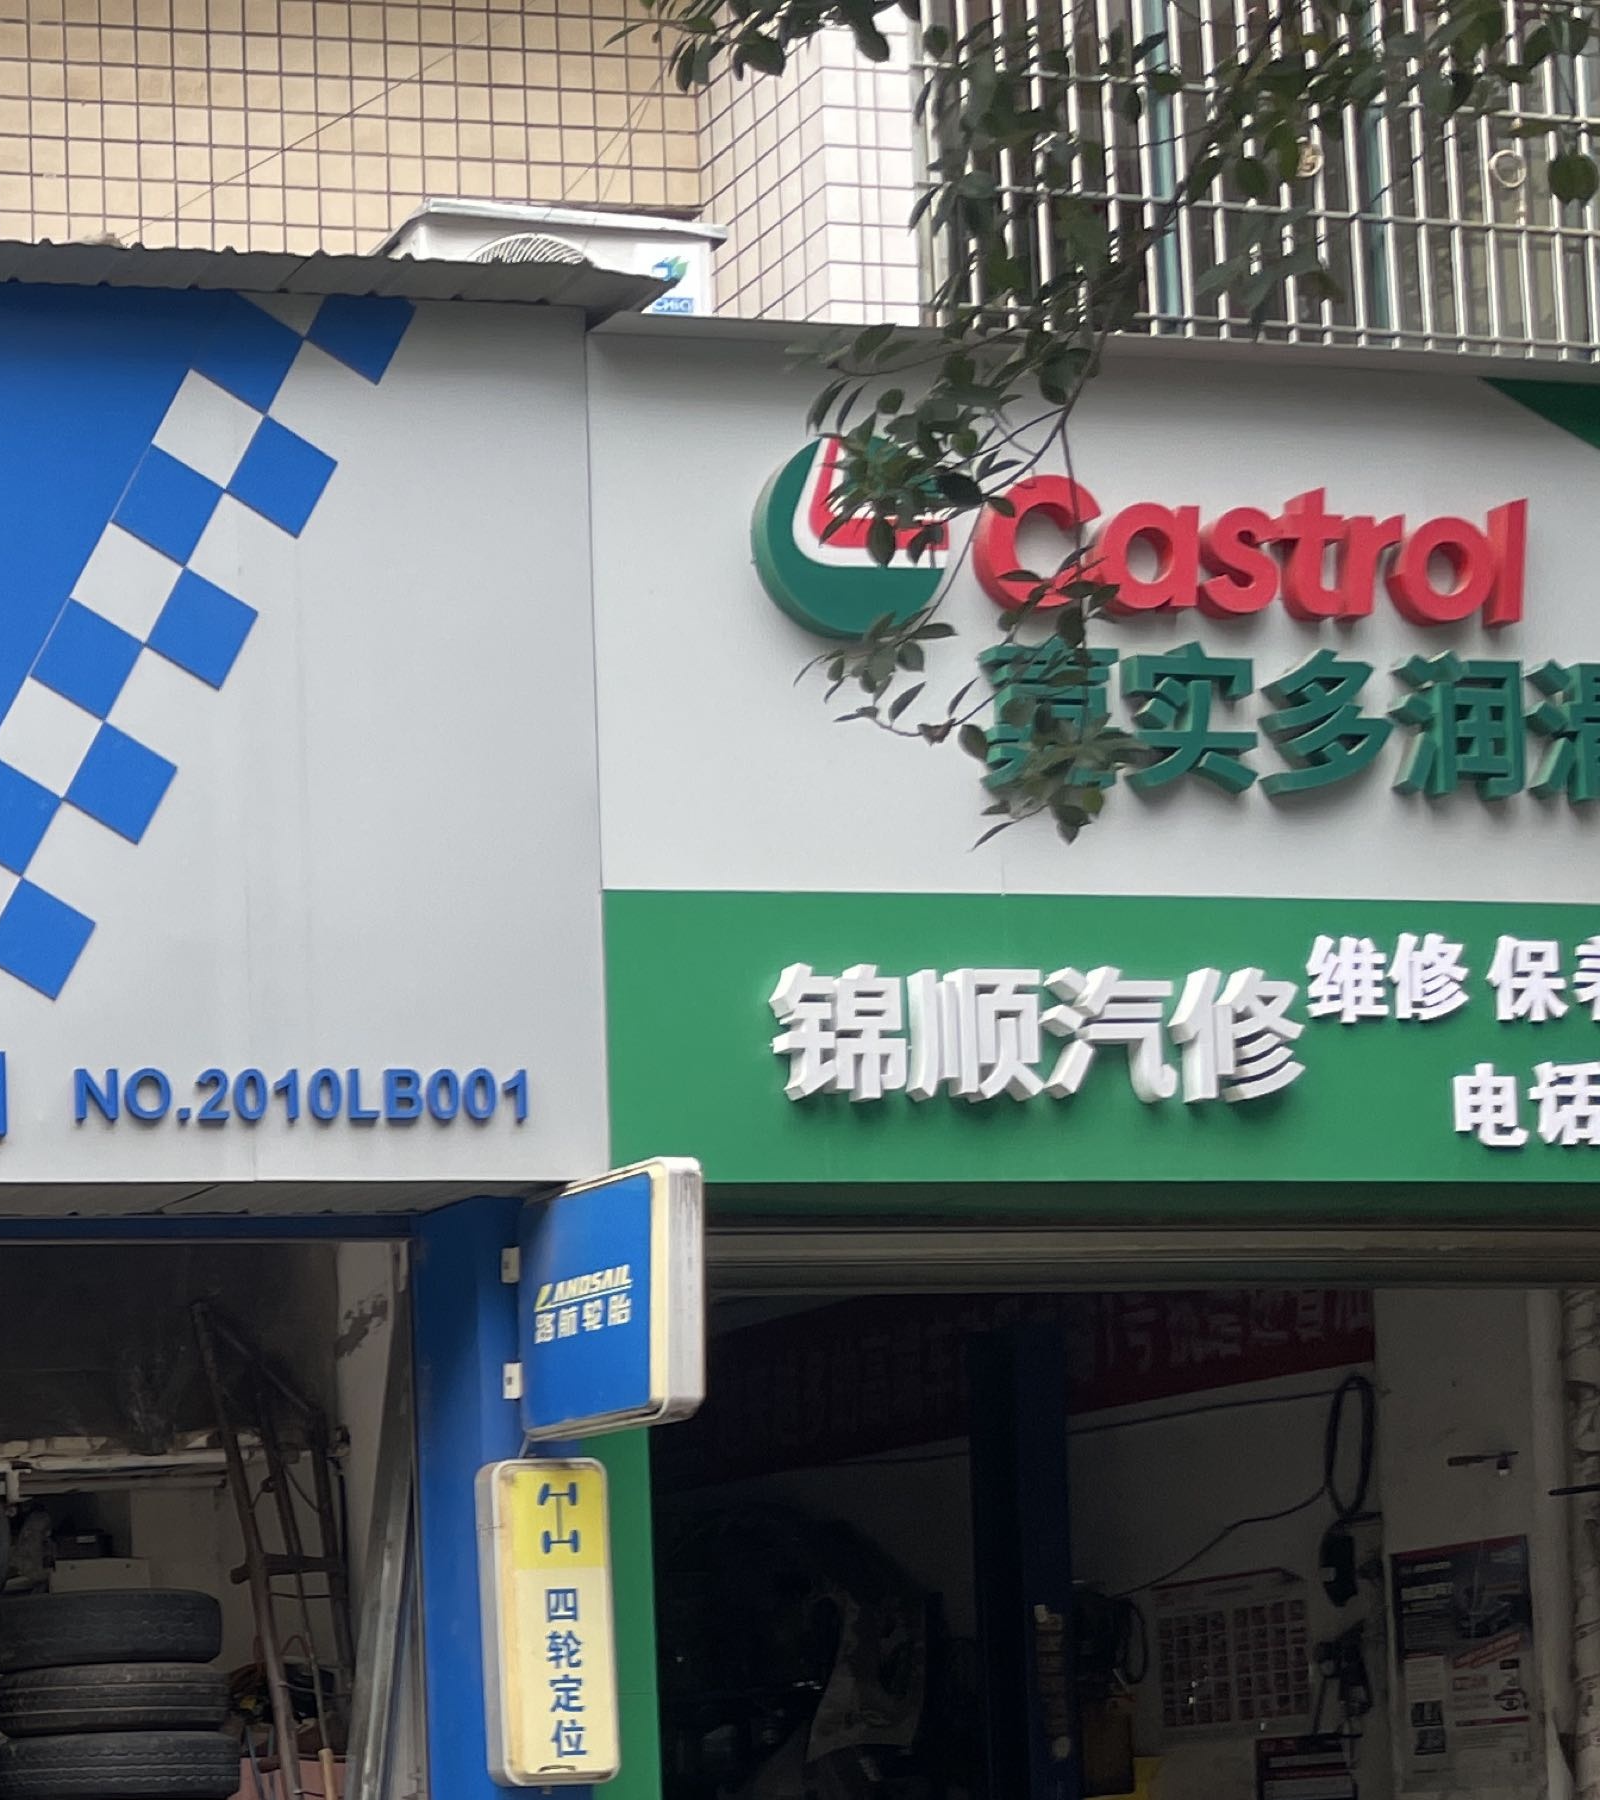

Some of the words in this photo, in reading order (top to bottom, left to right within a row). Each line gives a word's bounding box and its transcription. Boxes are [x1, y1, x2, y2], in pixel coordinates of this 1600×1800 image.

[972, 474, 1528, 628] Castrol
[770, 962, 1307, 1105] 锦顺汽修
[1305, 932, 1470, 1023] 维修
[74, 1065, 531, 1127] NO.2010LB001
[534, 1292, 632, 1344] 路航轮胎
[544, 1588, 588, 1758] 四轮定位
